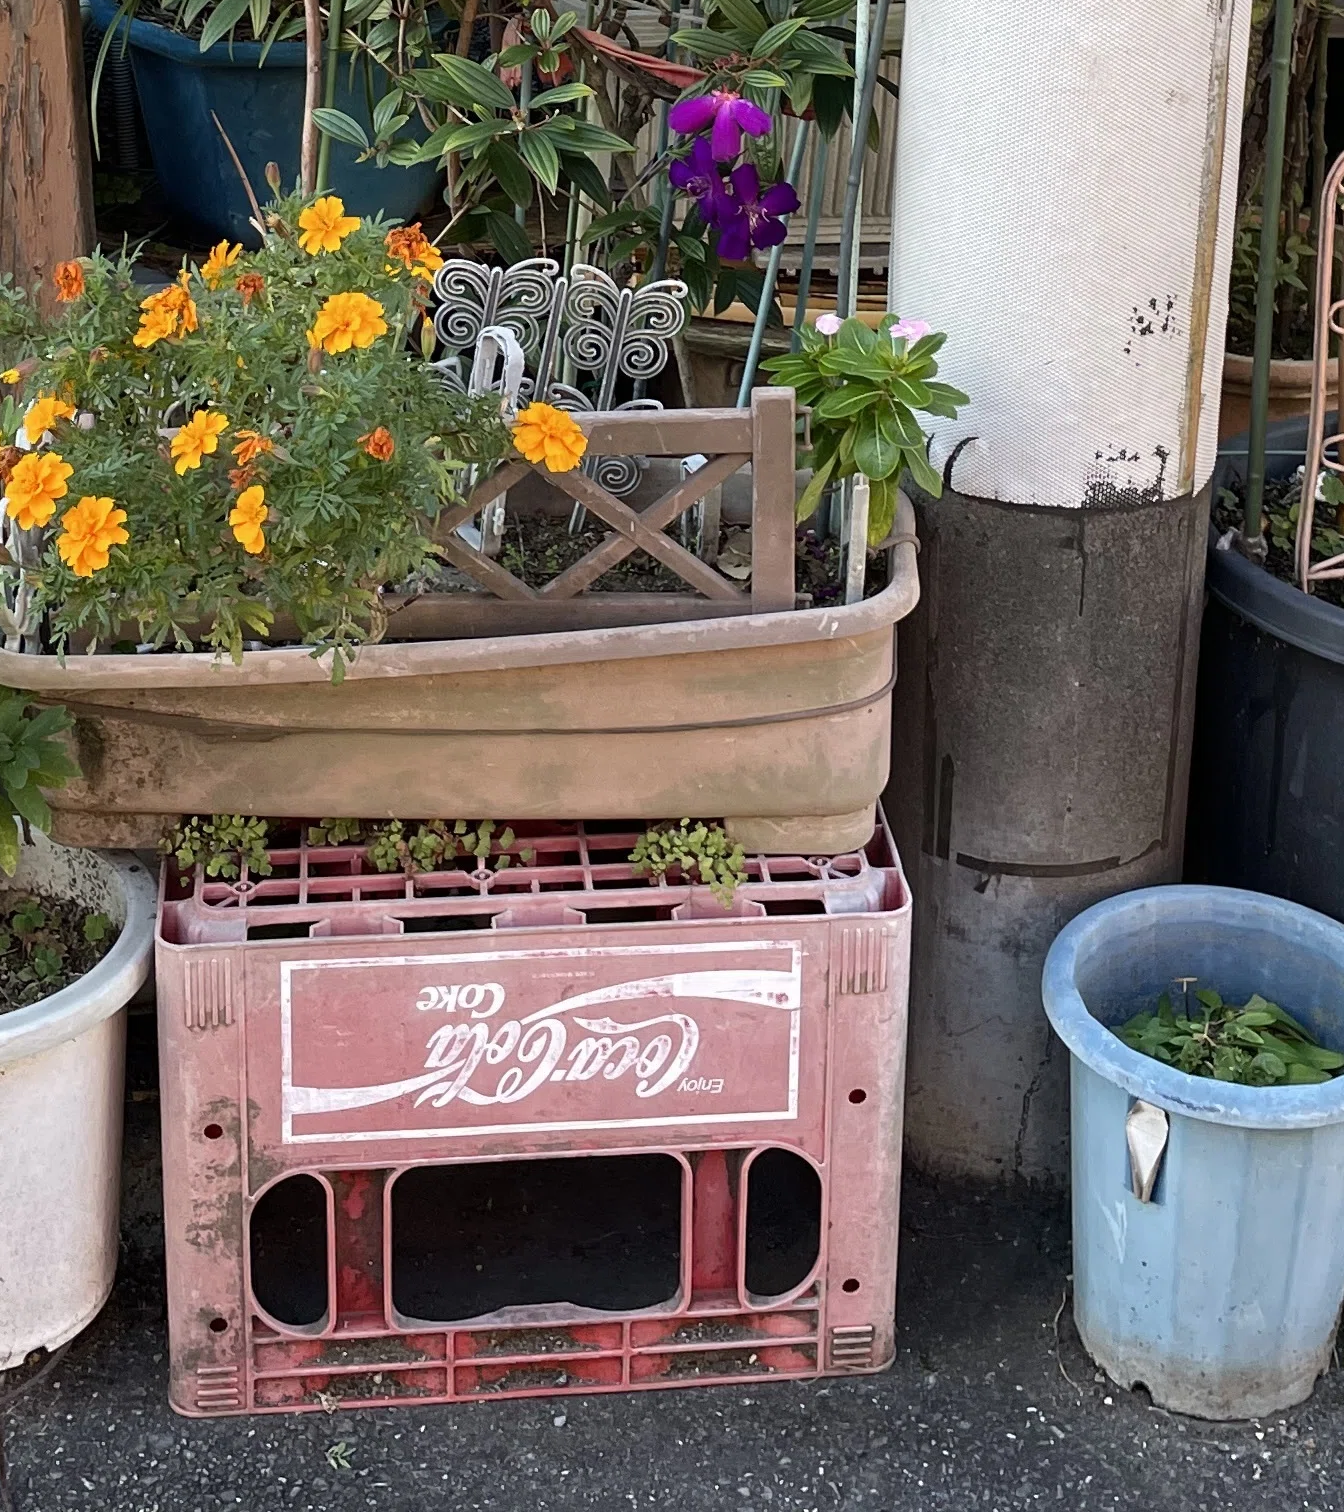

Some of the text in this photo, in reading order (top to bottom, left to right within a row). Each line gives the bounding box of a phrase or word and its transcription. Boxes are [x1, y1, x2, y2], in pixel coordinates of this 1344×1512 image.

[415, 982, 506, 1019] Coke
[413, 1012, 700, 1109] Coca-Cola
[676, 1077, 725, 1094] Enjoy
